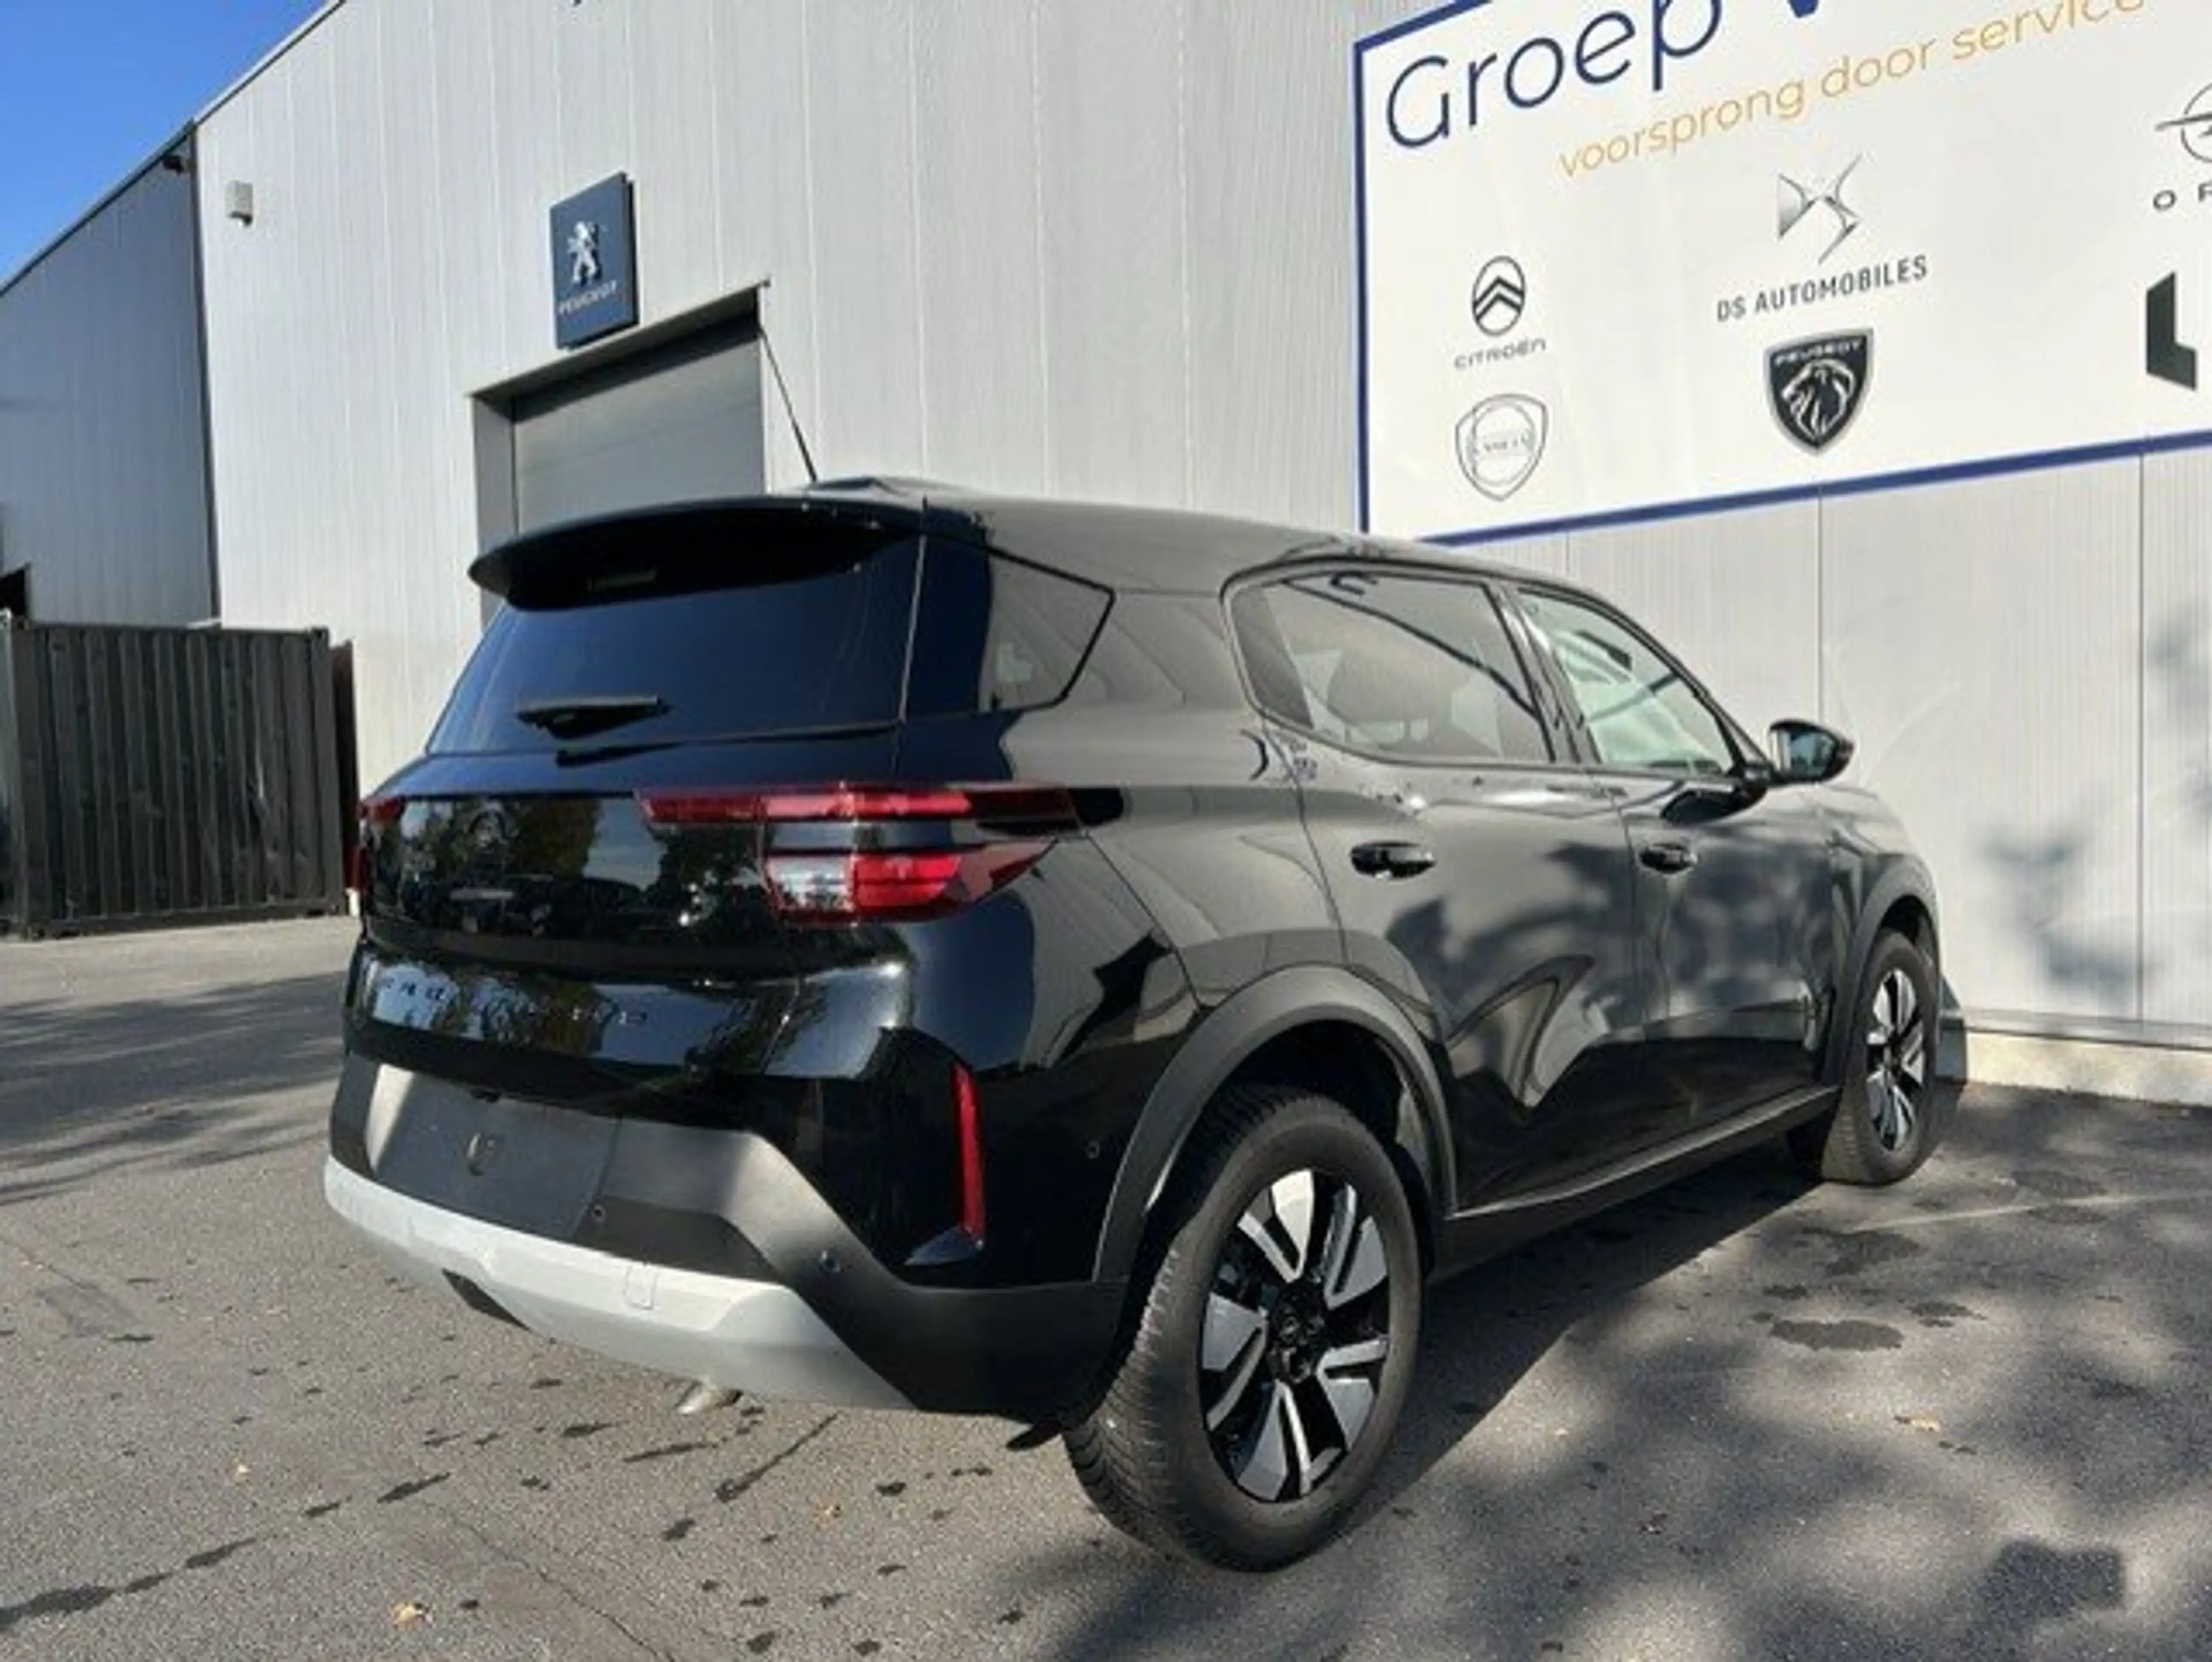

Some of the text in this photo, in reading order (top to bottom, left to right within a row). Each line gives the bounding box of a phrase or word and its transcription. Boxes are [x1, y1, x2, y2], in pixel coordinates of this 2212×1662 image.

[1387, 0, 1722, 148] Groep
[1560, 80, 1804, 177] voorsprong
[1821, 38, 1936, 98] door
[1717, 254, 1927, 322] DS AUTOMOBILES
